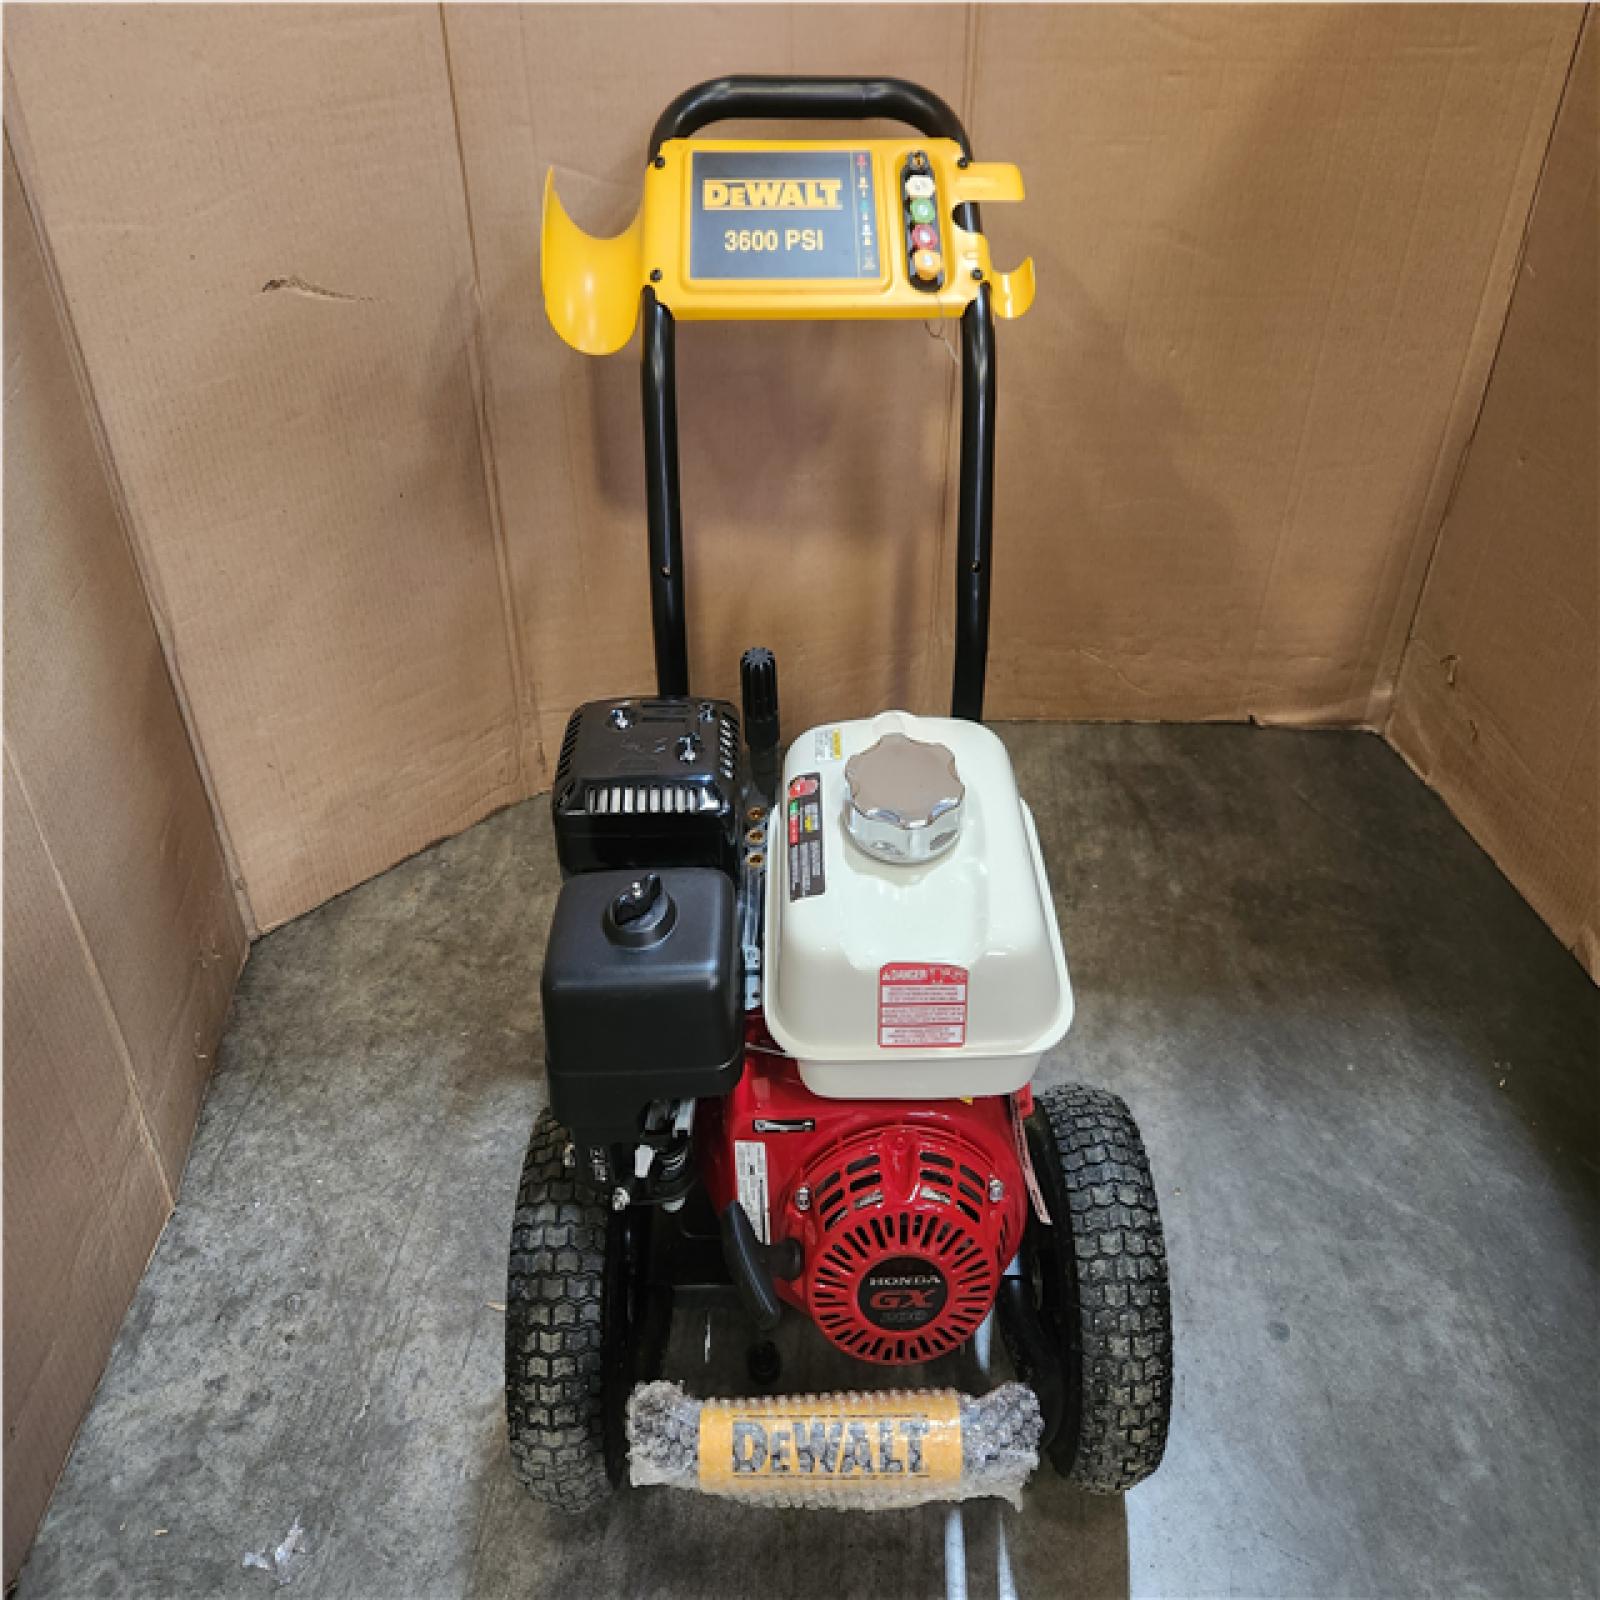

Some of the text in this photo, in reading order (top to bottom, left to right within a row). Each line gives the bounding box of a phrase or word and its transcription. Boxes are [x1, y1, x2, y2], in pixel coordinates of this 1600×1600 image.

[703, 179, 843, 210] DEWALT
[724, 229, 824, 251] 3600 PSI
[870, 1289, 937, 1310] GX
[732, 1418, 928, 1474] DEWALT
